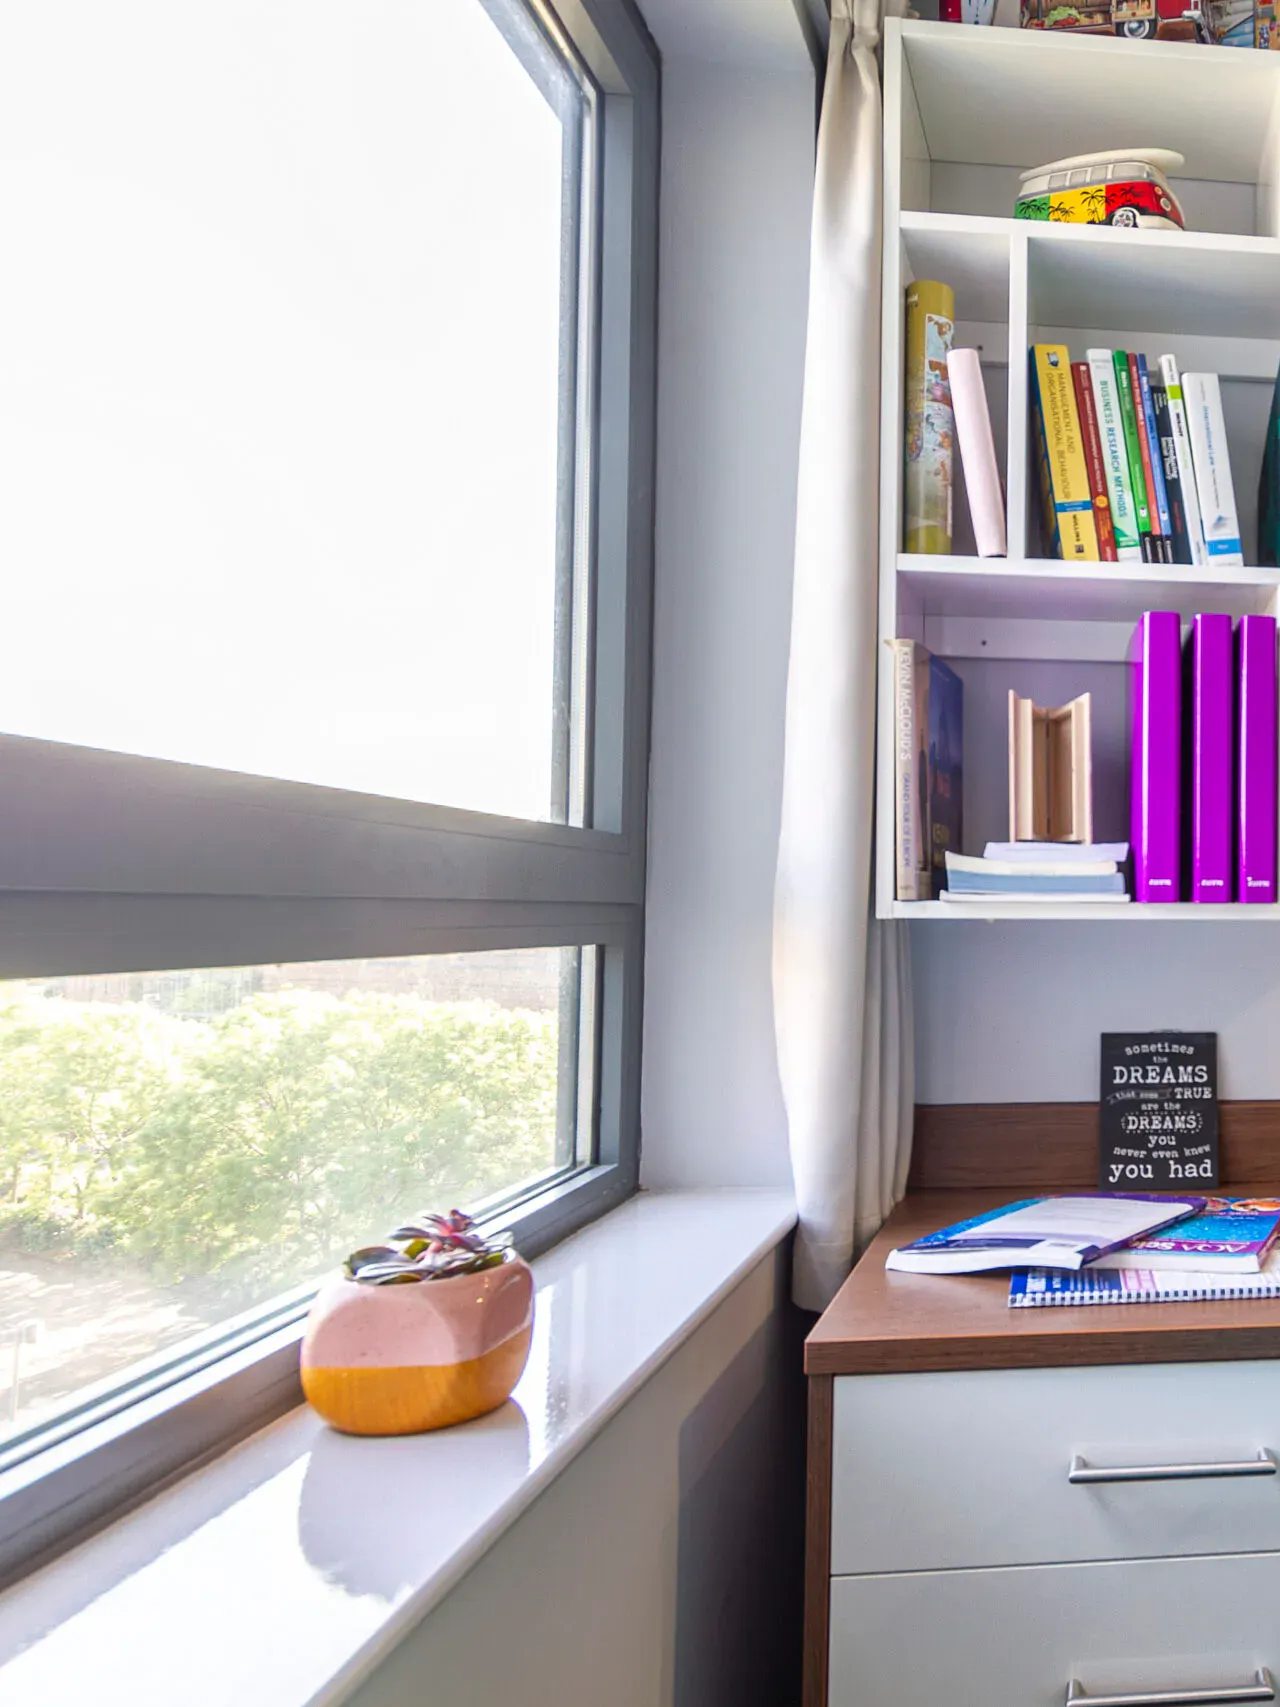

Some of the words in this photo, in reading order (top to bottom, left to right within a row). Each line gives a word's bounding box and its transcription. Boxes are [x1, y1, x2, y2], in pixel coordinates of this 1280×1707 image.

[1101, 381, 1114, 424] BUSINESS
[1057, 373, 1072, 432] MANAGEMENT
[1066, 436, 1075, 454] AND
[1046, 372, 1063, 446] ORGANISATIONAL
[1057, 450, 1071, 499] BEHAVIOUR
[1107, 427, 1120, 473] RESEARCH
[1114, 476, 1127, 518] METHODS
[900, 646, 912, 685] KEVIN
[1125, 1042, 1194, 1056] sometimes
[1153, 1055, 1168, 1064] the
[1113, 1065, 1208, 1084] DREAMS
[1115, 1090, 1135, 1100] that
[1174, 1087, 1212, 1099] TRUE
[1164, 1102, 1181, 1110] the
[1127, 1115, 1197, 1130] DREAMS
[1113, 1147, 1147, 1158] never
[1152, 1150, 1179, 1158] even
[1184, 1144, 1211, 1157] knew
[1147, 1135, 1176, 1148] you
[1108, 1164, 1154, 1183] you
[1168, 1159, 1213, 1178] had
